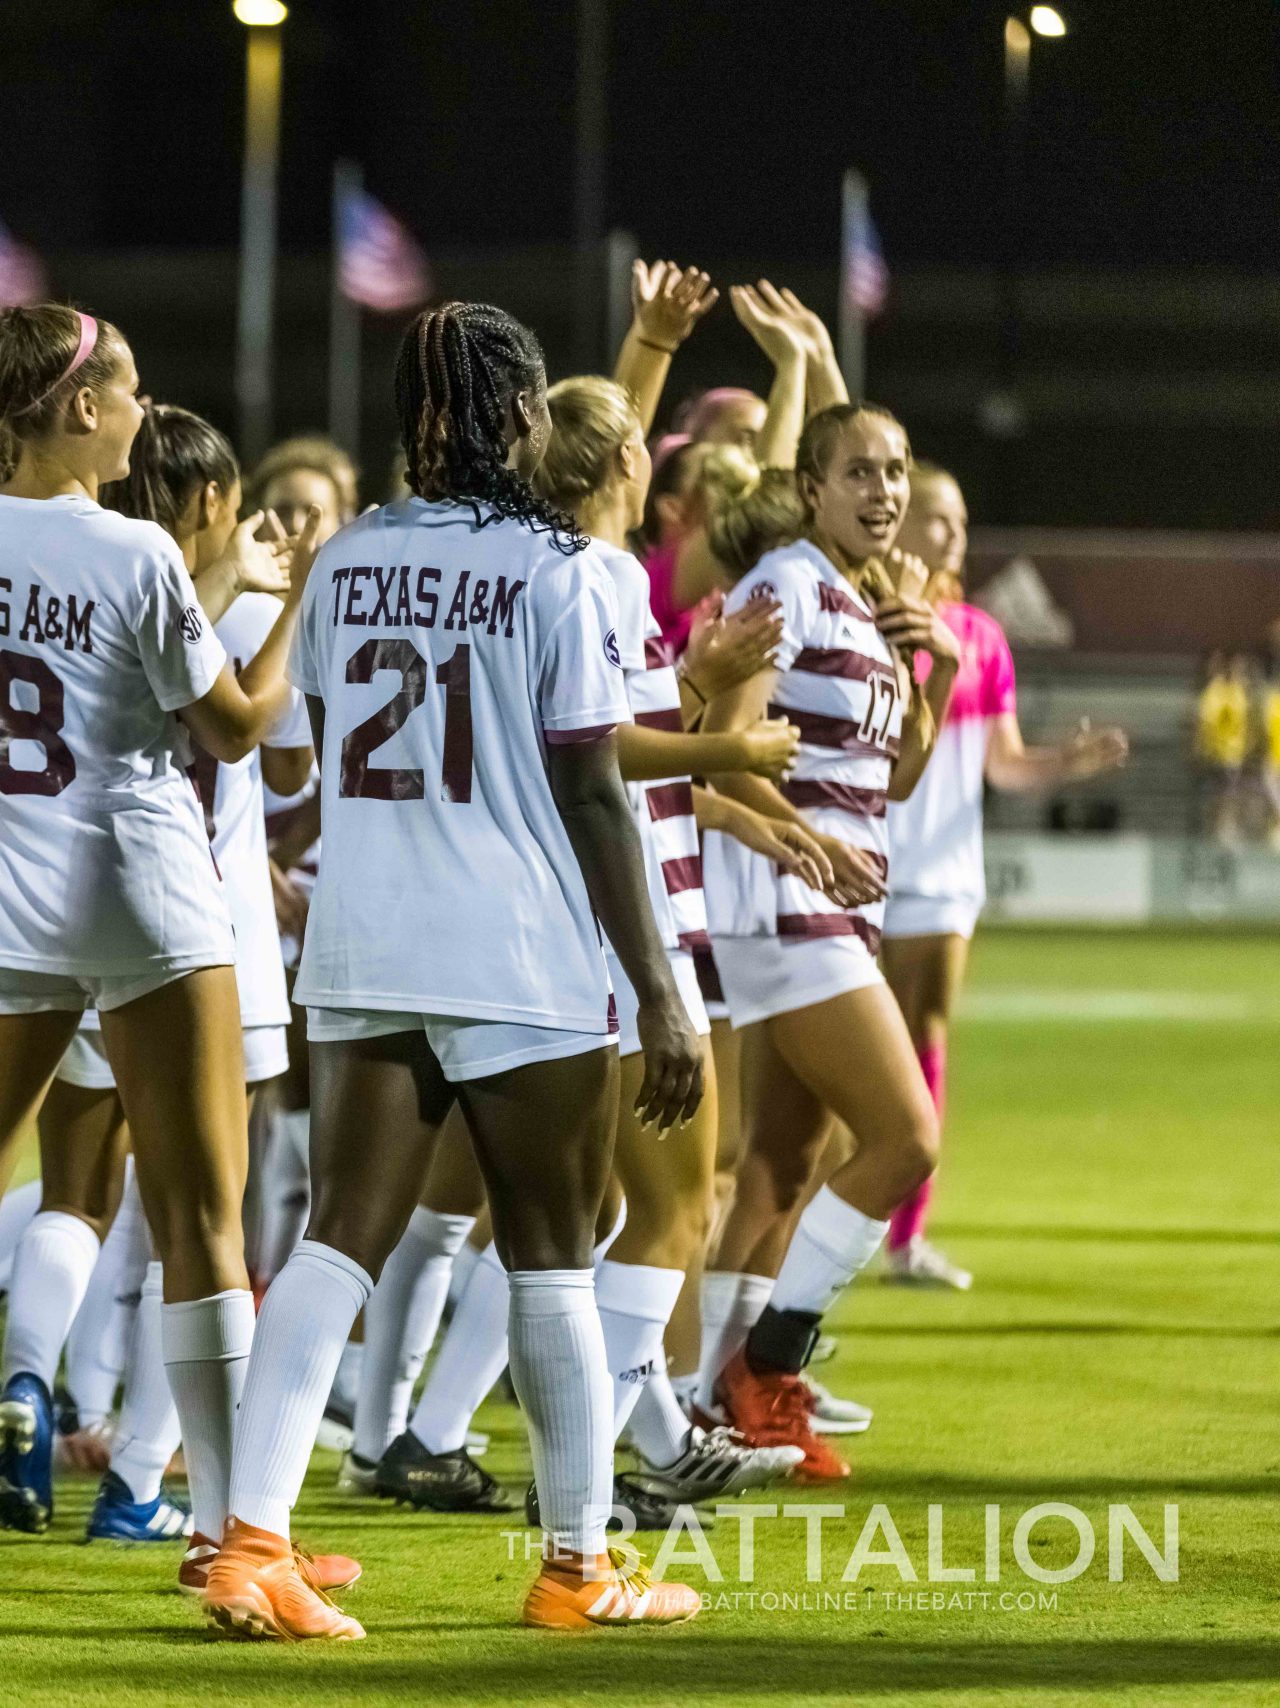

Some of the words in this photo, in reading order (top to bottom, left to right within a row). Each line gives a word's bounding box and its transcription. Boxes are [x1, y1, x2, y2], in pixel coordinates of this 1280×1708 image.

[19, 583, 96, 654] A&M
[331, 565, 442, 629] TEXAS
[443, 570, 528, 639] A&M
[338, 638, 473, 804] 21
[857, 670, 899, 750] 17
